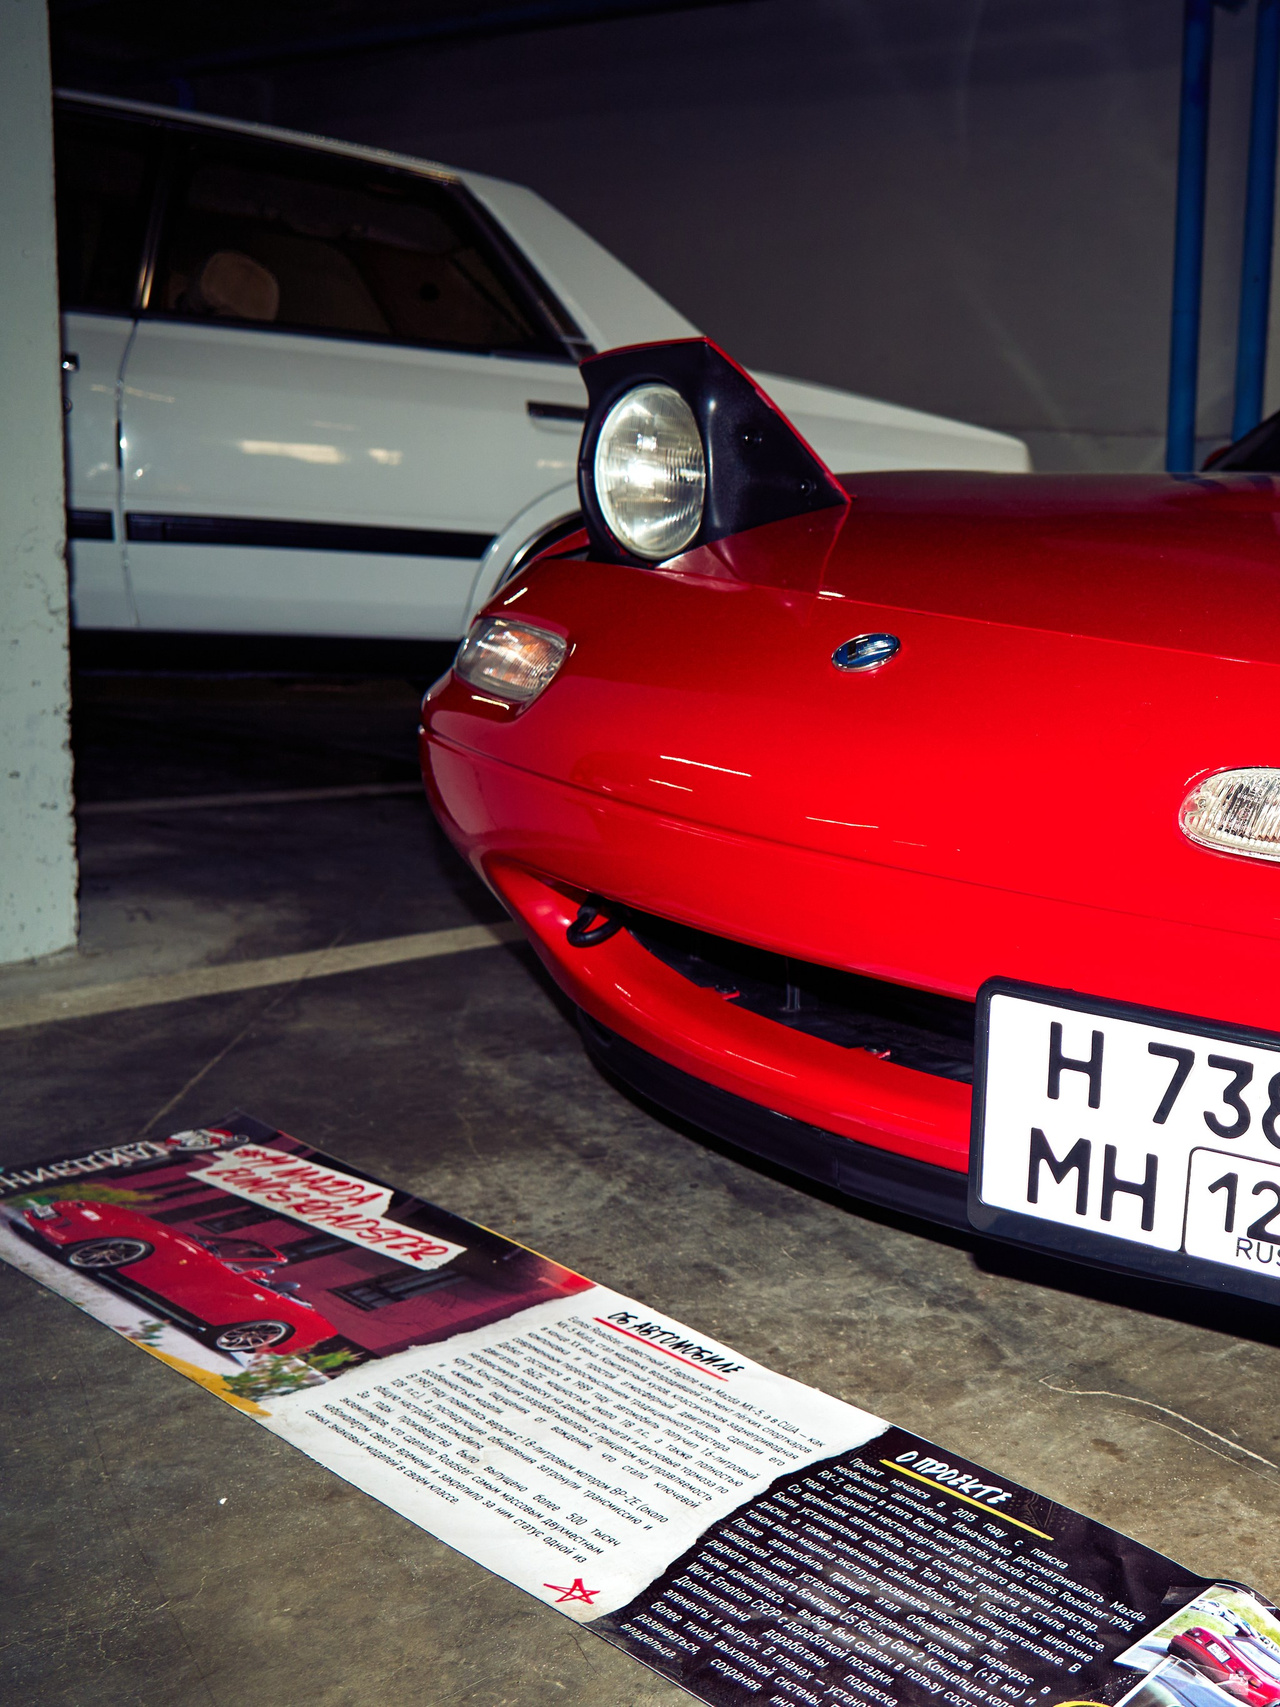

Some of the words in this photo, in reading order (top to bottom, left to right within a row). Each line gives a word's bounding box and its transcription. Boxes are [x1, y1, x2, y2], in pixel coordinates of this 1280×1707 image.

[0, 1140, 170, 1194] ГАЙДЗИН
[206, 1167, 309, 1202] EUNOS
[284, 1199, 448, 1261] ROADSTER
[271, 1166, 383, 1207] MAZDA
[607, 1311, 639, 1325] ОБ
[626, 1322, 745, 1373] АВТОМОБИЛЕ
[356, 1390, 370, 1399] За
[372, 1401, 392, 1413] годы
[398, 1415, 452, 1447] производства
[455, 1449, 480, 1463] было
[483, 1466, 528, 1492] выпущено
[532, 1494, 561, 1511] более
[565, 1512, 588, 1525] 500
[590, 1528, 620, 1546] тысяч
[369, 1432, 398, 1448] своего
[395, 1448, 432, 1469] времени
[438, 1474, 483, 1501] закрепило
[481, 1500, 496, 1508] за
[494, 1507, 514, 1519] ним
[513, 1518, 544, 1537] статус
[543, 1536, 576, 1555] одной
[572, 1554, 587, 1563] из
[390, 1426, 405, 1436] что
[402, 1435, 437, 1455] сделало
[436, 1453, 474, 1475] Roadster
[471, 1476, 501, 1493] самым
[500, 1492, 544, 1519] массовым
[541, 1518, 603, 1554] двухместным
[849, 1457, 884, 1476] Проект
[889, 1478, 930, 1499] начался
[952, 1507, 978, 1522] 2015
[982, 1523, 1008, 1538] году
[1030, 1548, 1068, 1569] поиска
[895, 1450, 919, 1463] О
[911, 1457, 1013, 1504] ПРОЕКТЕ
[731, 1517, 763, 1537] Позже
[767, 1538, 823, 1570] автомобиль
[829, 1571, 870, 1595] прошёл
[874, 1596, 901, 1612] этап
[906, 1614, 974, 1652] обновления:
[979, 1653, 1034, 1684] перекрас
[1040, 1686, 1051, 1694] в
[745, 1509, 775, 1526] таком
[772, 1524, 799, 1539] виде
[796, 1537, 836, 1559] машина
[835, 1557, 930, 1611] эксплуатировалась
[931, 1609, 987, 1641] несколько
[985, 1639, 1008, 1654] лет.
[756, 1501, 789, 1520] диски,
[801, 1523, 832, 1541] также
[832, 1540, 883, 1568] заменены
[884, 1567, 955, 1607] сайлентблоки
[955, 1605, 972, 1616] на
[973, 1615, 1063, 1666] полиуретановые.
[1068, 1662, 1082, 1672] В
[772, 1491, 799, 1508] Были
[797, 1507, 862, 1540] установлены
[862, 1539, 918, 1569] койловеры
[919, 1567, 941, 1583] Tein
[943, 1580, 977, 1603] Street,
[980, 1601, 1041, 1635] подобраны
[1043, 1634, 1093, 1662] широкие
[787, 1483, 802, 1493] Со
[801, 1492, 849, 1517] временем
[849, 1516, 903, 1547] автомобиль
[906, 1546, 933, 1560] стал
[932, 1559, 978, 1584] основой
[976, 1582, 1020, 1607] проекта
[1021, 1605, 1032, 1613] в
[1032, 1611, 1065, 1630] стиле
[1066, 1628, 1104, 1652] stance.
[801, 1477, 825, 1491] года
[831, 1494, 873, 1513] редкий
[877, 1515, 955, 1555] нестандартный
[949, 1554, 973, 1567] для
[972, 1564, 1008, 1584] своего
[1007, 1582, 1054, 1608] времени
[1050, 1605, 1098, 1632] родстер.
[817, 1469, 844, 1486] RX-7,
[843, 1483, 878, 1501] однако
[885, 1503, 913, 1519] итоге
[912, 1517, 934, 1531] был
[933, 1529, 992, 1560] приобретён
[991, 1557, 1029, 1578] Mazda
[1025, 1574, 1059, 1594] Eunos
[1059, 1591, 1108, 1618] Roadster
[1108, 1615, 1134, 1631] 1994
[833, 1465, 888, 1492] необычного
[891, 1492, 947, 1524] автомобиля.
[952, 1522, 1012, 1555] Изначально
[1013, 1555, 1104, 1602] рассматривалась
[1109, 1601, 1146, 1621] Mazda
[620, 1623, 676, 1659] владельца.
[633, 1613, 700, 1654] развиваться,
[710, 1658, 762, 1690] сохраняя
[650, 1601, 682, 1622] более
[683, 1620, 715, 1641] тихой
[714, 1640, 777, 1677] выхлопной
[663, 1589, 713, 1619] элементы
[711, 1617, 723, 1625] и
[721, 1623, 761, 1649] выпуск.
[761, 1646, 776, 1655] В
[772, 1654, 814, 1679] планах
[823, 1685, 870, 1707] устано
[672, 1575, 751, 1621] Дополнительно
[762, 1629, 829, 1667] доработаны
[686, 1561, 714, 1580] Work
[710, 1576, 752, 1602] Emotion
[750, 1599, 782, 1617] CR2P
[783, 1621, 850, 1658] доработкой
[845, 1655, 894, 1684] посадки.
[697, 1551, 729, 1570] также
[727, 1568, 784, 1603] изменилась
[797, 1608, 832, 1630] выбор
[831, 1627, 856, 1643] был
[854, 1641, 895, 1665] сделан
[893, 1662, 905, 1671] в
[904, 1668, 945, 1693] пользу
[943, 1691, 977, 1707] сост
[704, 1539, 748, 1563] редкого
[745, 1560, 798, 1591] переднего
[796, 1588, 841, 1615] бампера
[839, 1611, 859, 1624] US
[854, 1619, 892, 1646] Racing
[890, 1640, 914, 1656] Gen
[911, 1651, 925, 1663] 2.
[923, 1658, 987, 1697] Концепция
[719, 1529, 773, 1558] заводской
[769, 1557, 796, 1574] цвет,
[795, 1572, 850, 1603] установка
[848, 1602, 924, 1642] расширенных
[925, 1641, 973, 1670] крыльев
[974, 1667, 1002, 1684] (+15
[1000, 1683, 1026, 1698] мм)
[1024, 1696, 1037, 1705] и
